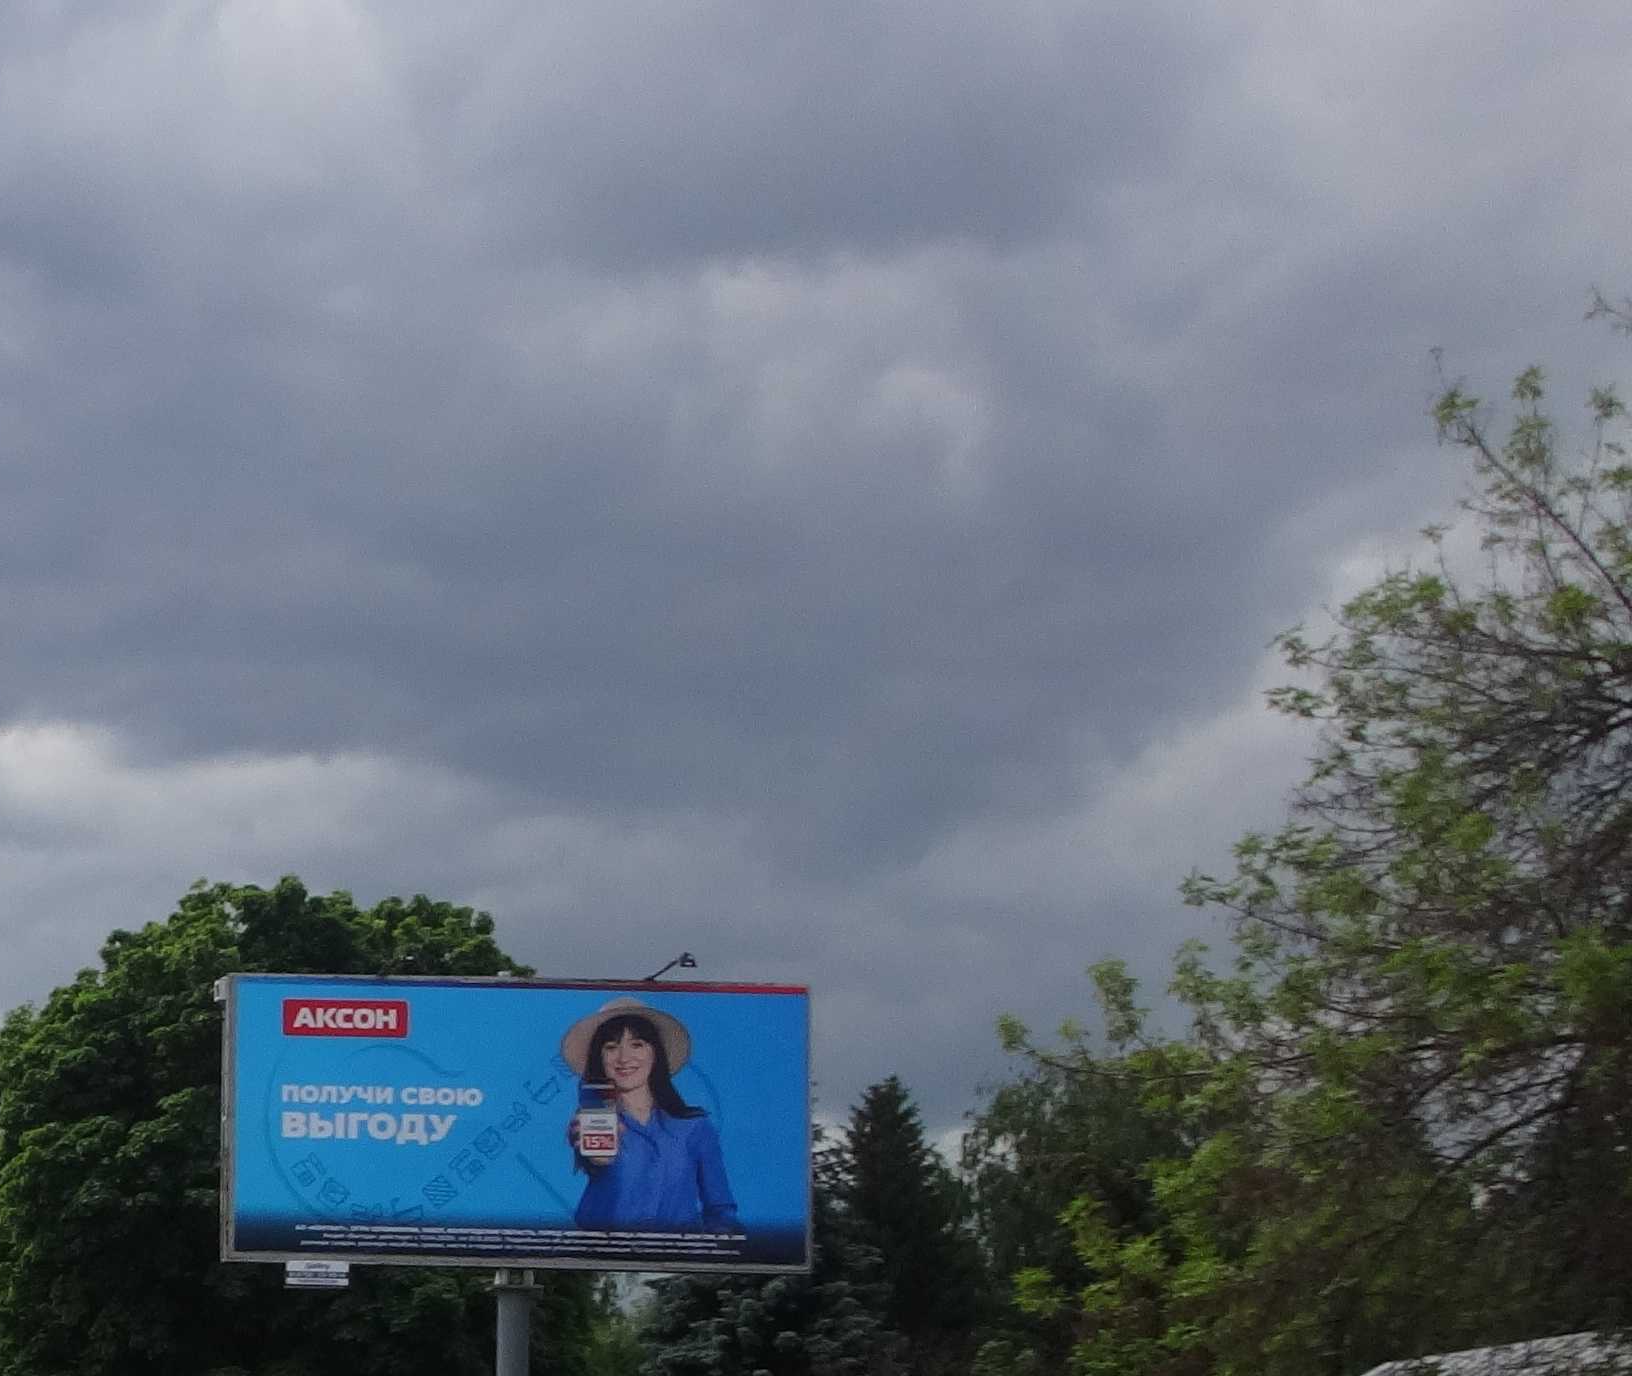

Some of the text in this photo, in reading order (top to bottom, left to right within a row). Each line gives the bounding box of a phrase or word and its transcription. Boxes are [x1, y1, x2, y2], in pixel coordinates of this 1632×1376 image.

[293, 1007, 397, 1029] АКСОН
[281, 1084, 483, 1106] ПОЛУЧИ СВОЮ
[281, 1111, 457, 1145] ВЫГОДУ
